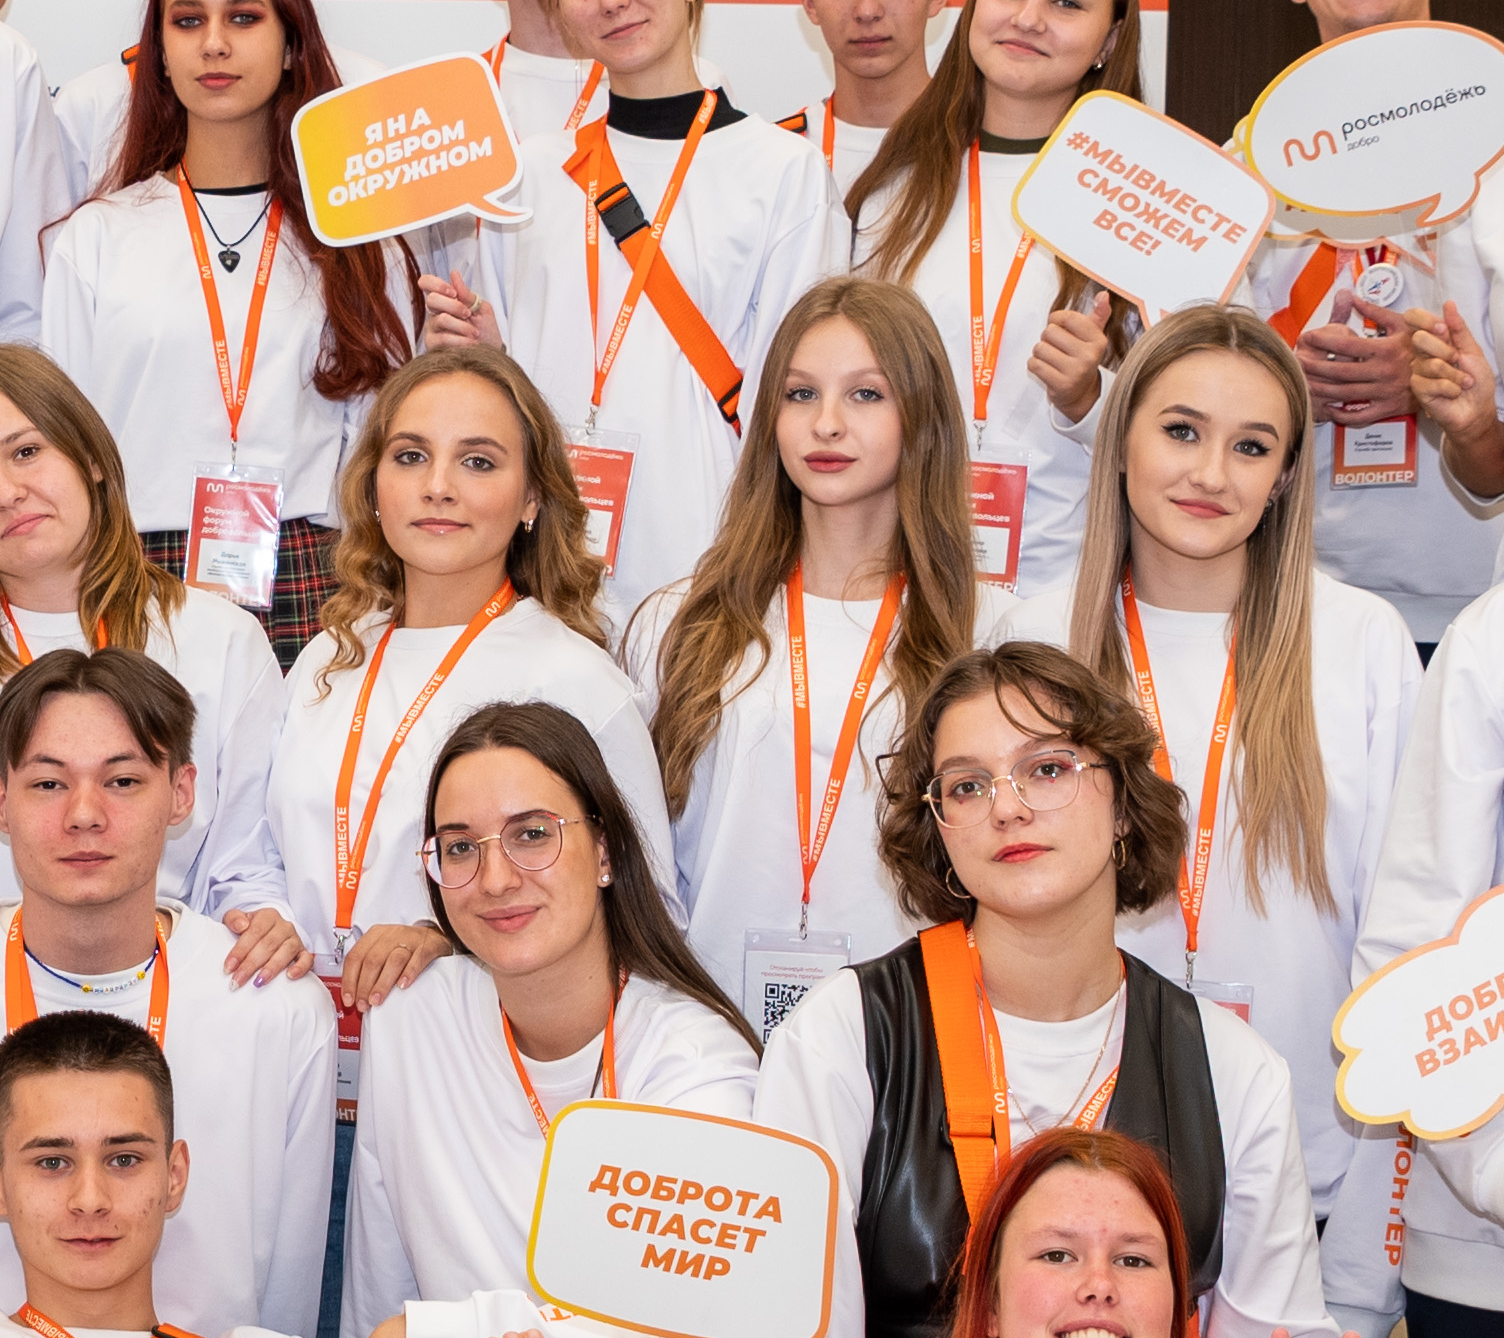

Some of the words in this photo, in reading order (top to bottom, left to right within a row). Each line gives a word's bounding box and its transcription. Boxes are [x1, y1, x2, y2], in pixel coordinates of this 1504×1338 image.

[1339, 80, 1487, 142] росмолодёжь
[1346, 133, 1380, 152] добро
[326, 135, 493, 208] ОКРУЖНОМ
[343, 119, 466, 183] ДОБРОМ
[1064, 130, 1248, 246] #МЫВМЕСТЕ
[1076, 166, 1209, 253] СМОЖЕМ
[1093, 209, 1163, 259] ВСЕ!
[602, 305, 633, 376] #МЫВМЕСТЕ
[973, 314, 984, 388] ЫВМЕСТЕ
[1334, 470, 1415, 485] ВОЛОНТЕР
[792, 635, 806, 708] #МЫВМЕСТЕ
[394, 671, 445, 745] #МЫВМЕСТЕ
[812, 777, 841, 862] #МЫВМЕСТЕ
[1192, 827, 1212, 917] #МЫВМЕСТЕ
[587, 1163, 785, 1226] ДОБРОТА
[605, 1201, 768, 1256] СПАСЕТ
[1383, 1124, 1414, 1267] ЛОНЕР
[639, 1242, 732, 1284] МИР
